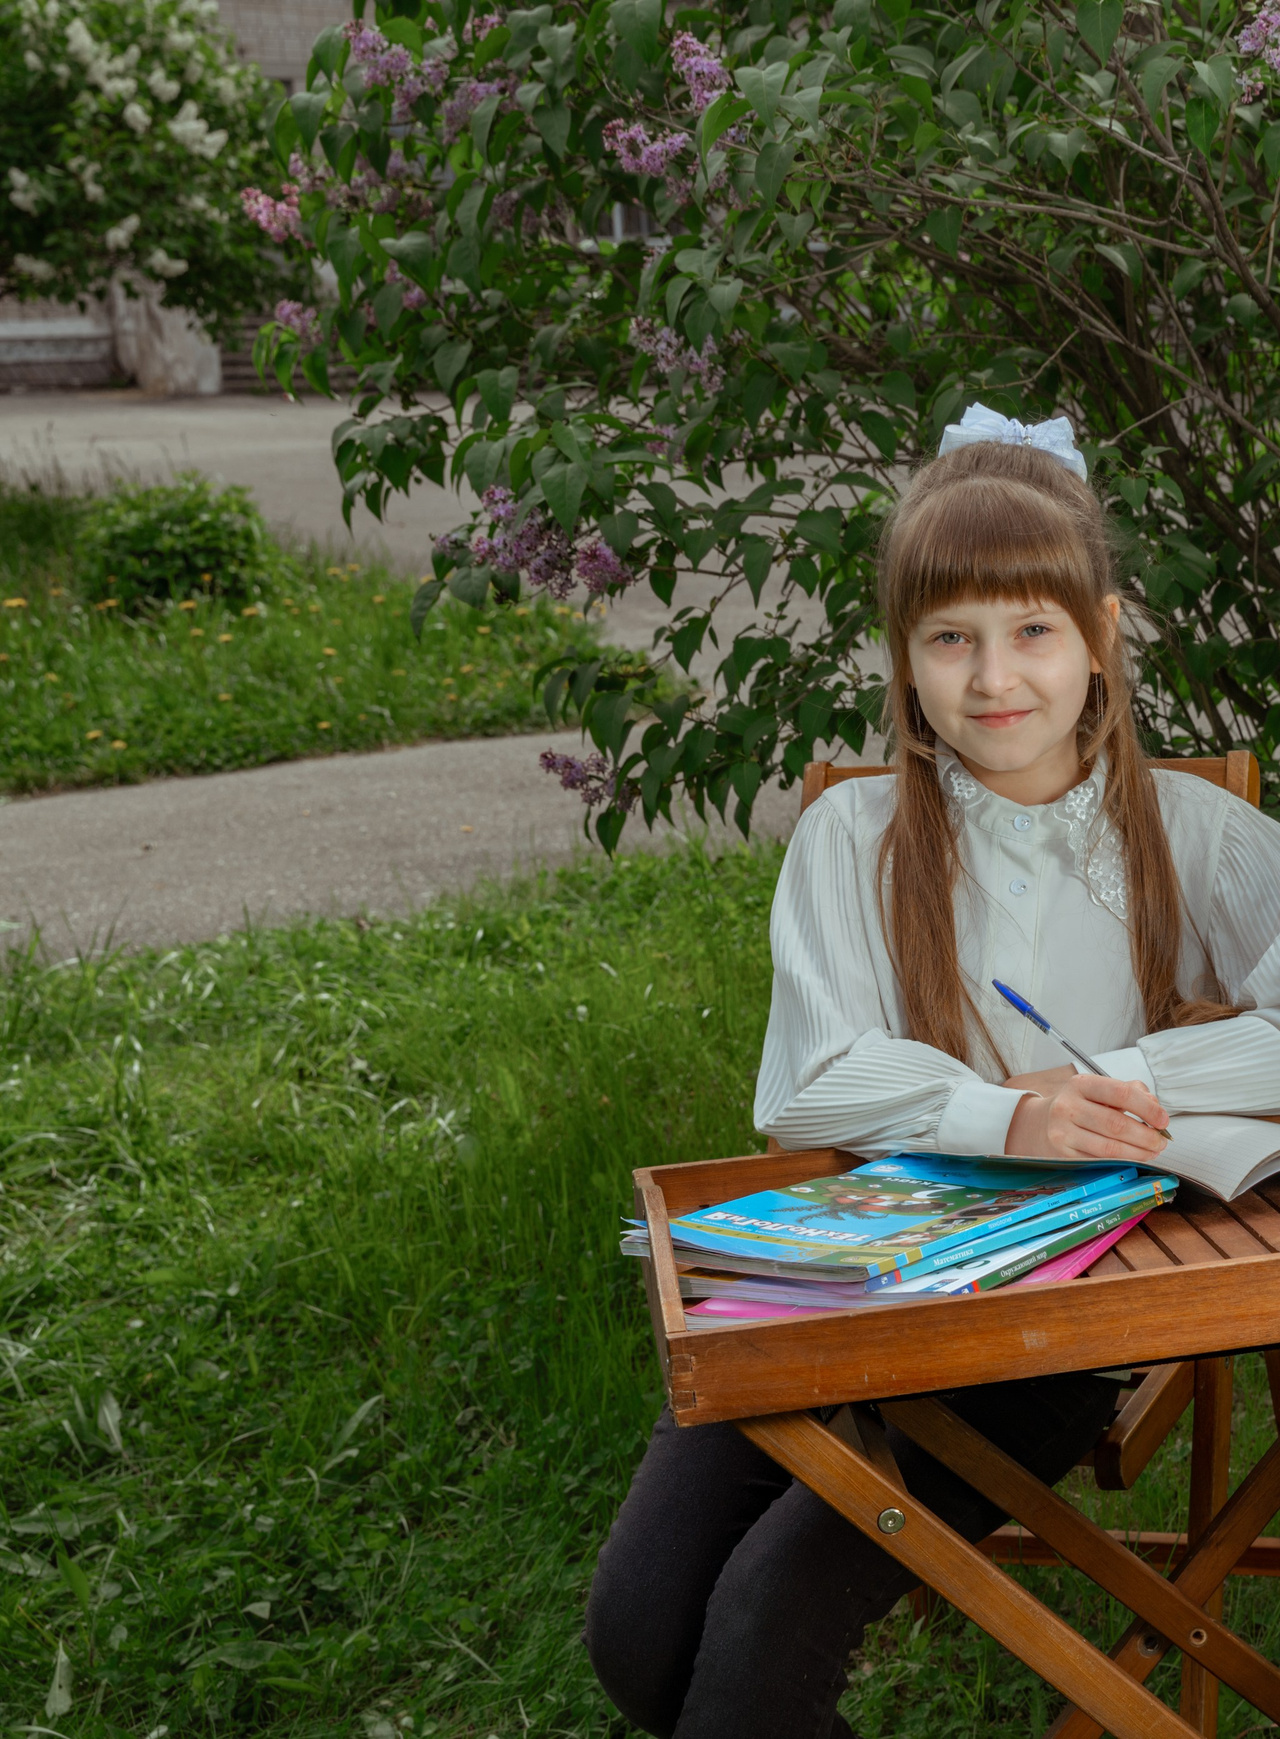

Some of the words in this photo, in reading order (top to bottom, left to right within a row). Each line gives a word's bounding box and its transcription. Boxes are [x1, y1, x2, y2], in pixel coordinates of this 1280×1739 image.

[933, 1248, 974, 1267] Математика
[1082, 1205, 1098, 1215] Часть
[1000, 1257, 1036, 1278] Окружающий
[1036, 1250, 1048, 1263] мир
[1106, 1215, 1118, 1225] Часть
